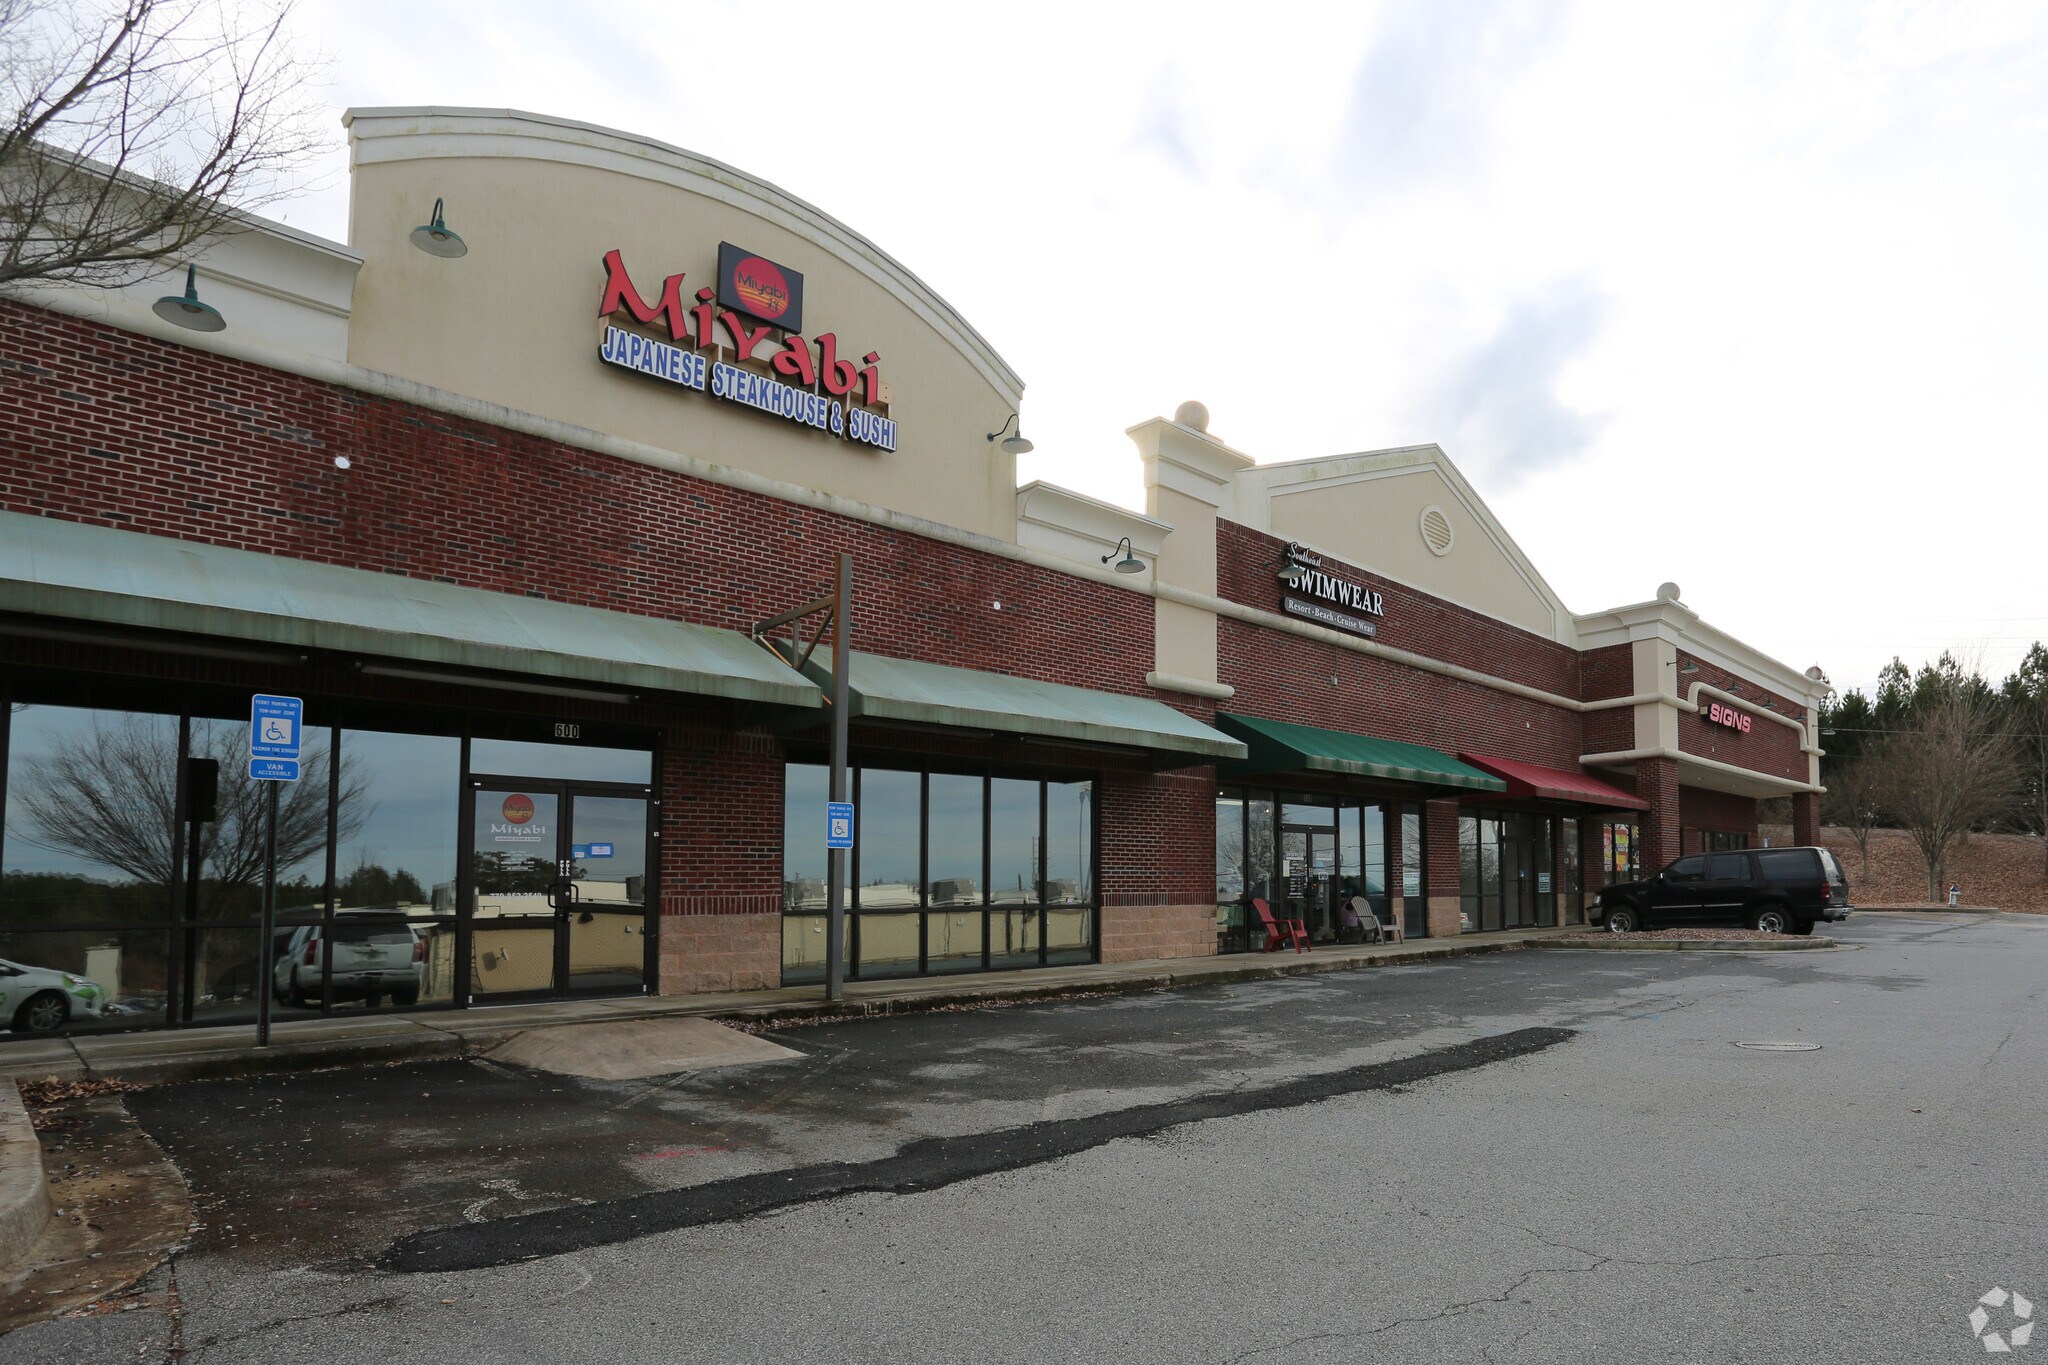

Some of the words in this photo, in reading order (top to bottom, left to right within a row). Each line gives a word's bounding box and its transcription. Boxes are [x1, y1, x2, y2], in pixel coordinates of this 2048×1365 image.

[738, 270, 786, 301] Miyabi
[599, 249, 881, 407] Miyabi
[601, 325, 706, 391] JAPANESE
[711, 361, 827, 430] STEAKHOUSE
[830, 400, 845, 436] &
[849, 406, 898, 451] SUSHI
[1288, 599, 1312, 615] Resort
[1314, 607, 1334, 622] Beach
[1336, 614, 1357, 629] Cruise
[1358, 619, 1374, 634] Wear
[556, 724, 578, 738] 600
[1710, 703, 1751, 733] SIGNS
[490, 823, 546, 836] Miyabi
